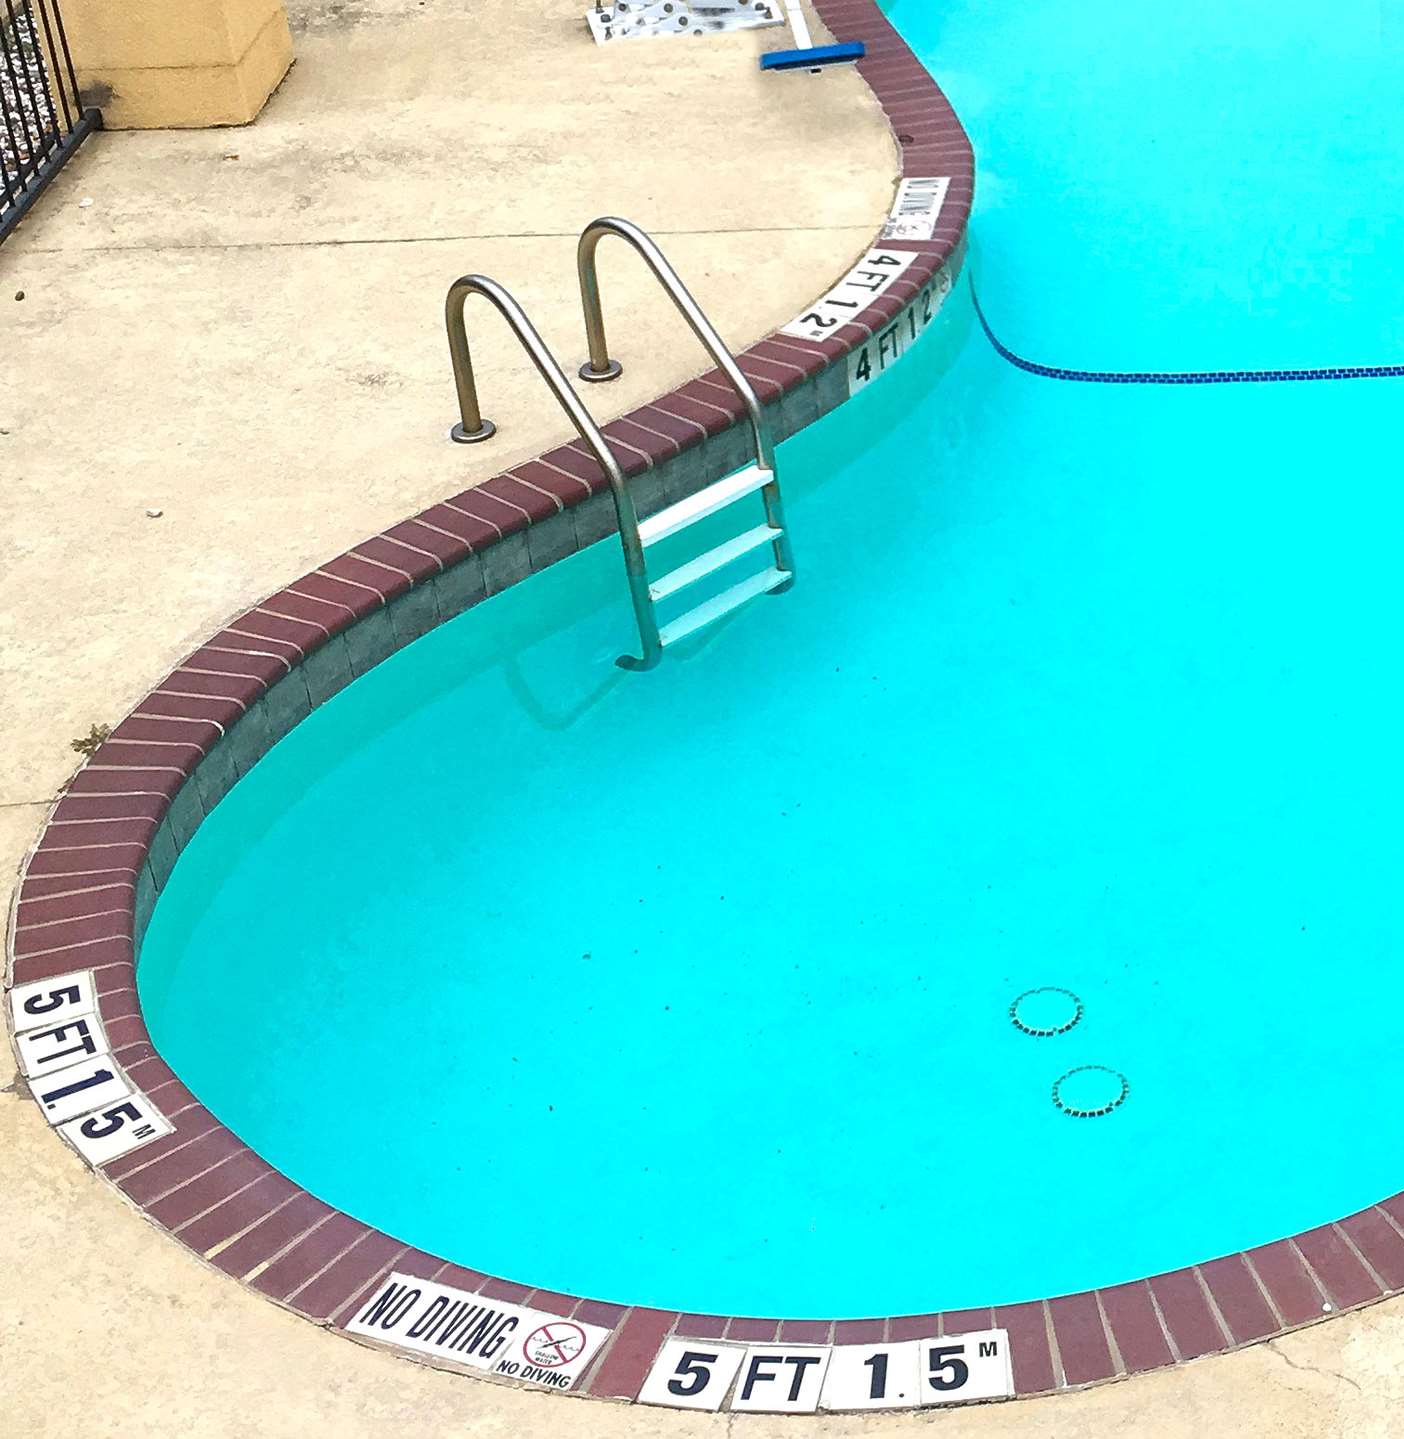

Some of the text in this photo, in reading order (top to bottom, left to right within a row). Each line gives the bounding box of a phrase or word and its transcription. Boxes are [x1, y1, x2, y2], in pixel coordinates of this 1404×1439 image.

[867, 255, 902, 265] 4
[845, 270, 890, 291] FT
[856, 347, 871, 381] 4
[879, 322, 899, 370] FT
[24, 985, 81, 1014] 5
[29, 1018, 97, 1064] FT
[359, 1282, 520, 1359] NO DIVING
[496, 1359, 571, 1388] NO DIVING
[667, 1351, 719, 1396] 5
[740, 1356, 821, 1401] FT
